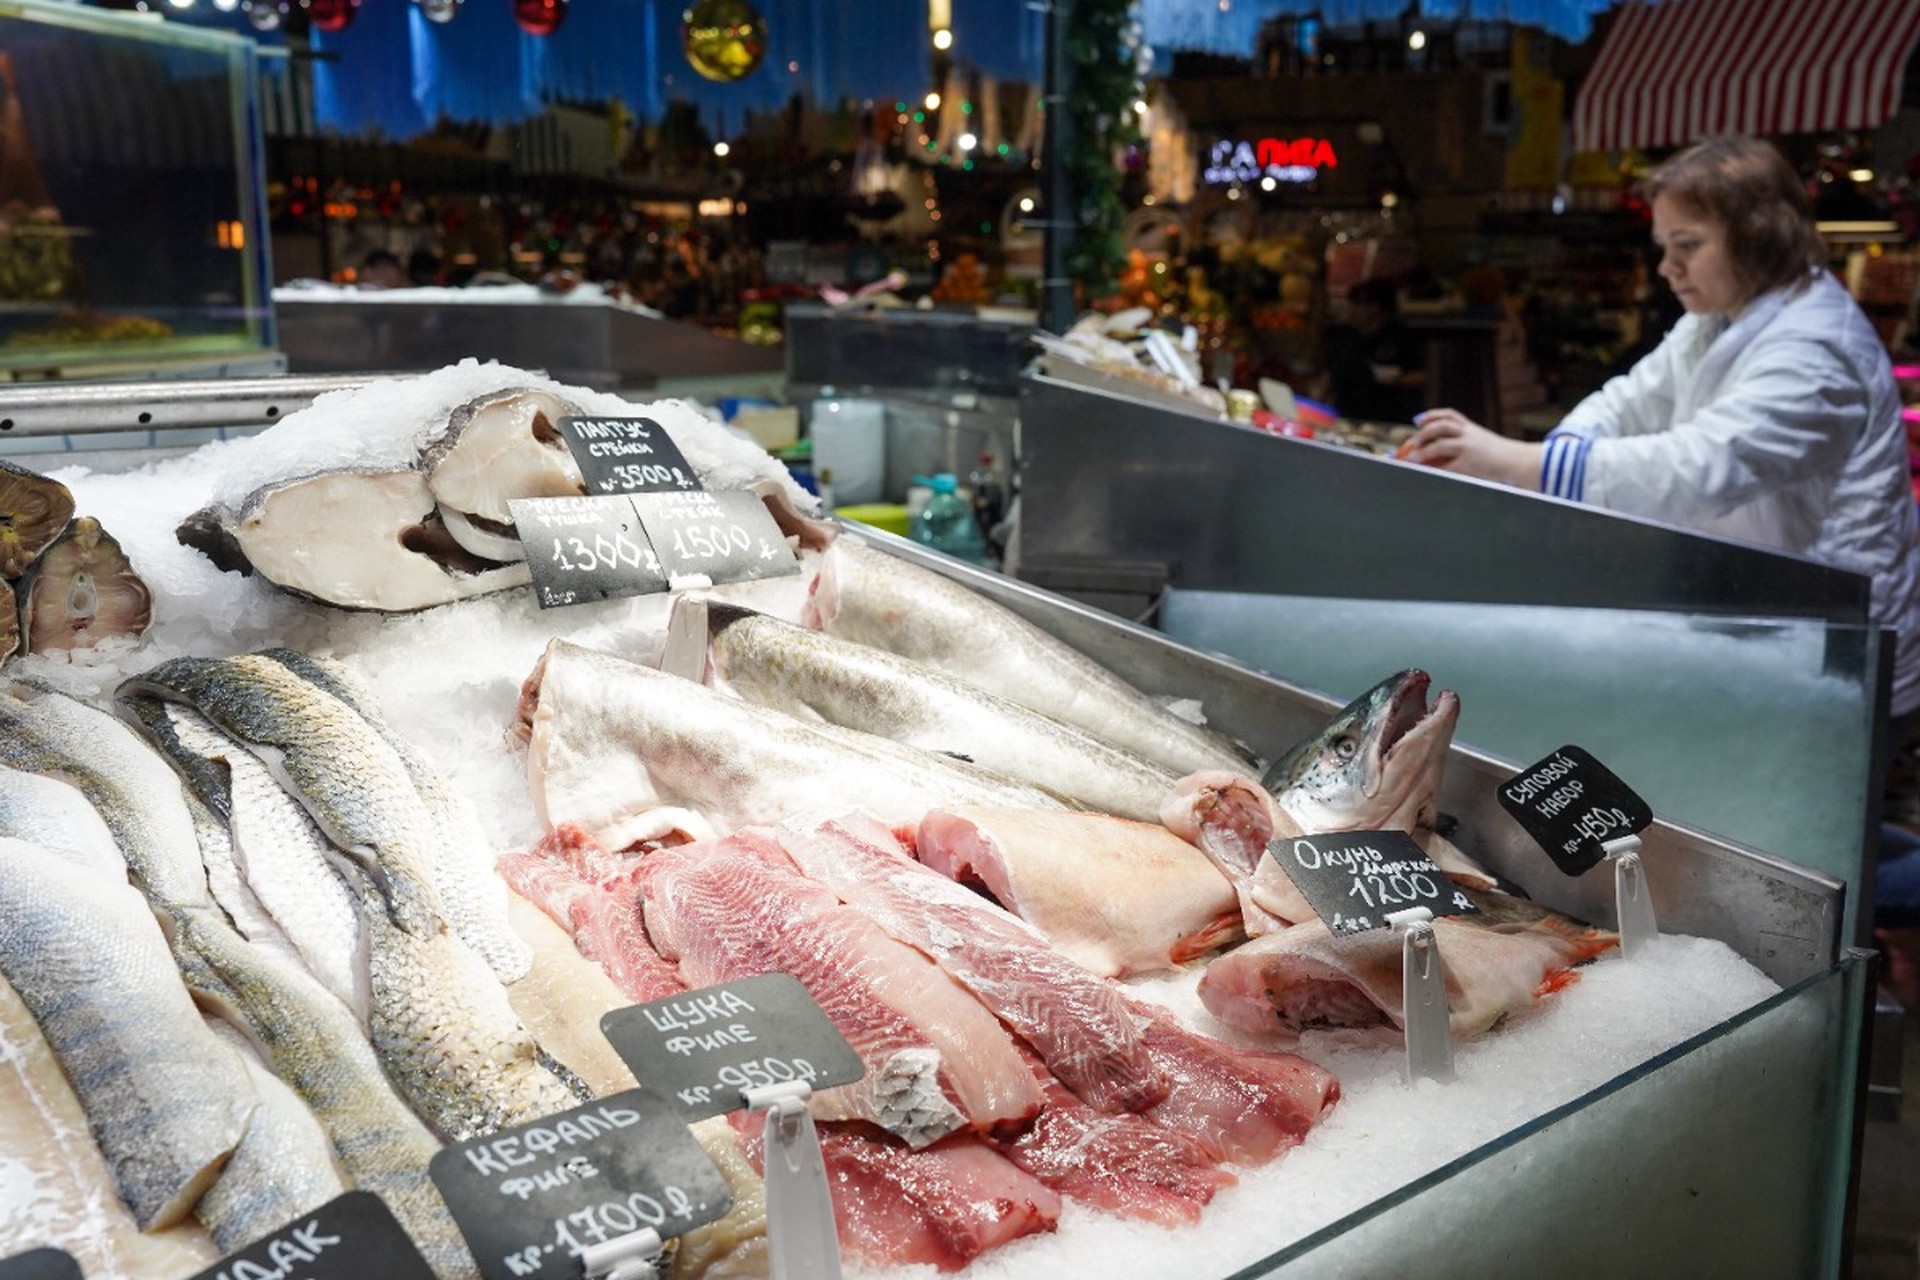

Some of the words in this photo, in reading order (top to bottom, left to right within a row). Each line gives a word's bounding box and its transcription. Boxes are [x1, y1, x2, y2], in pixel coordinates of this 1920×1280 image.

[572, 421, 650, 439] ПАЛТУС
[589, 440, 653, 457] СТЕЙКИ
[672, 525, 751, 559] 1500
[1505, 754, 1579, 805] СУПОВОЙ
[1536, 780, 1585, 819] НАБОР
[1348, 873, 1439, 907] 1200
[643, 990, 755, 1032] ЩУКА
[465, 1106, 641, 1177] КЕФАЛЬ
[217, 1220, 342, 1280] ДАК
